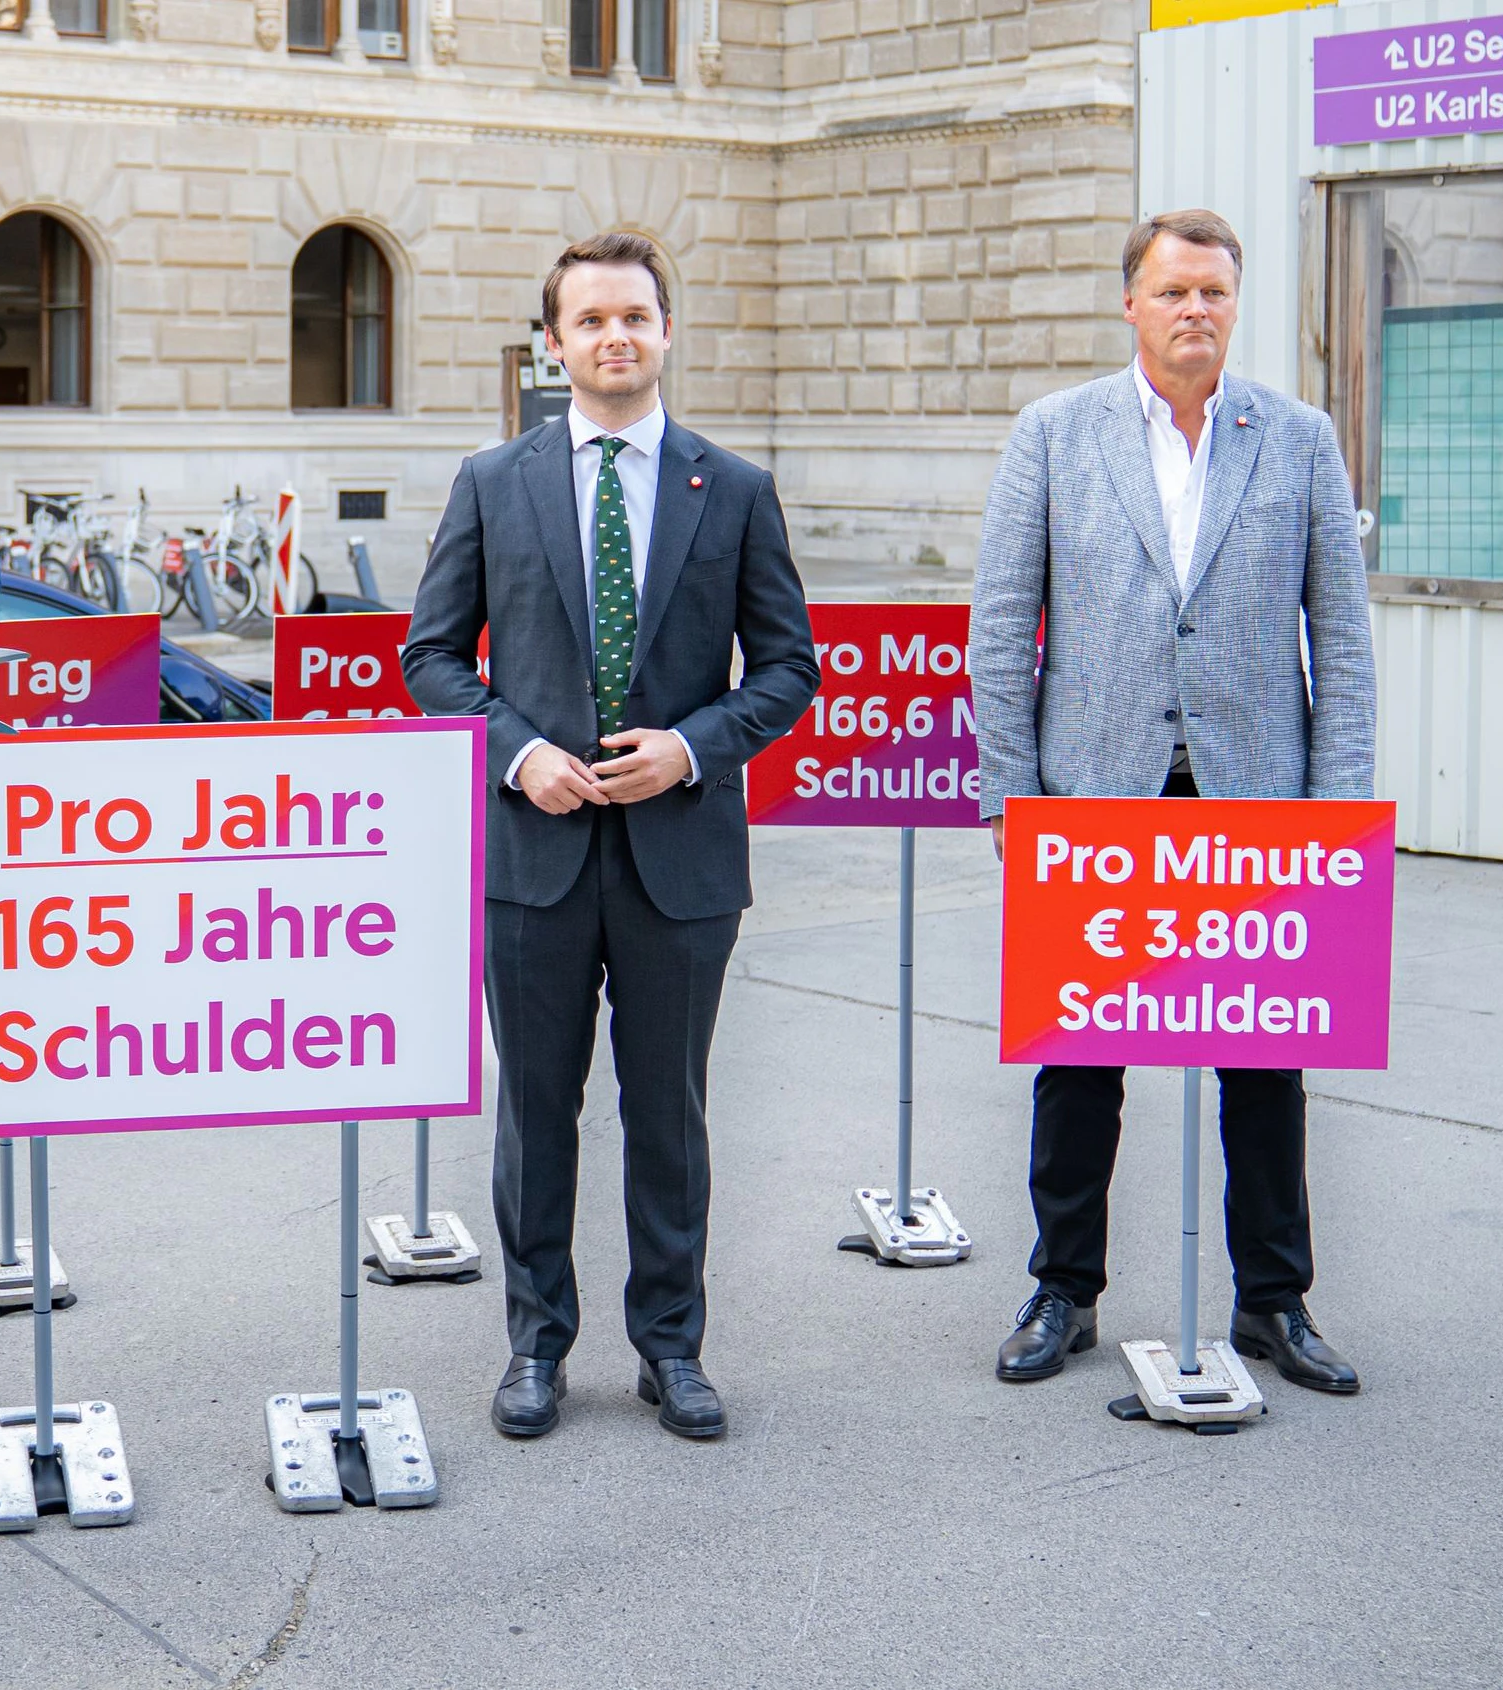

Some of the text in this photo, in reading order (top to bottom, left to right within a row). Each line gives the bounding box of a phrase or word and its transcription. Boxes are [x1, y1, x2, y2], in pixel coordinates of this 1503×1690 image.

[1414, 33, 1455, 68] U2
[1375, 94, 1415, 128] U2
[300, 647, 382, 689] Pro
[880, 634, 970, 675] Mo
[8, 658, 91, 703] Tag
[810, 695, 933, 744] 166,6
[6, 774, 385, 856] Pro Jahr:
[1036, 834, 1364, 886] Pro Minute
[164, 887, 396, 964] Jahre
[1084, 908, 1308, 960] € 3.800
[1057, 982, 1331, 1034] Schulden
